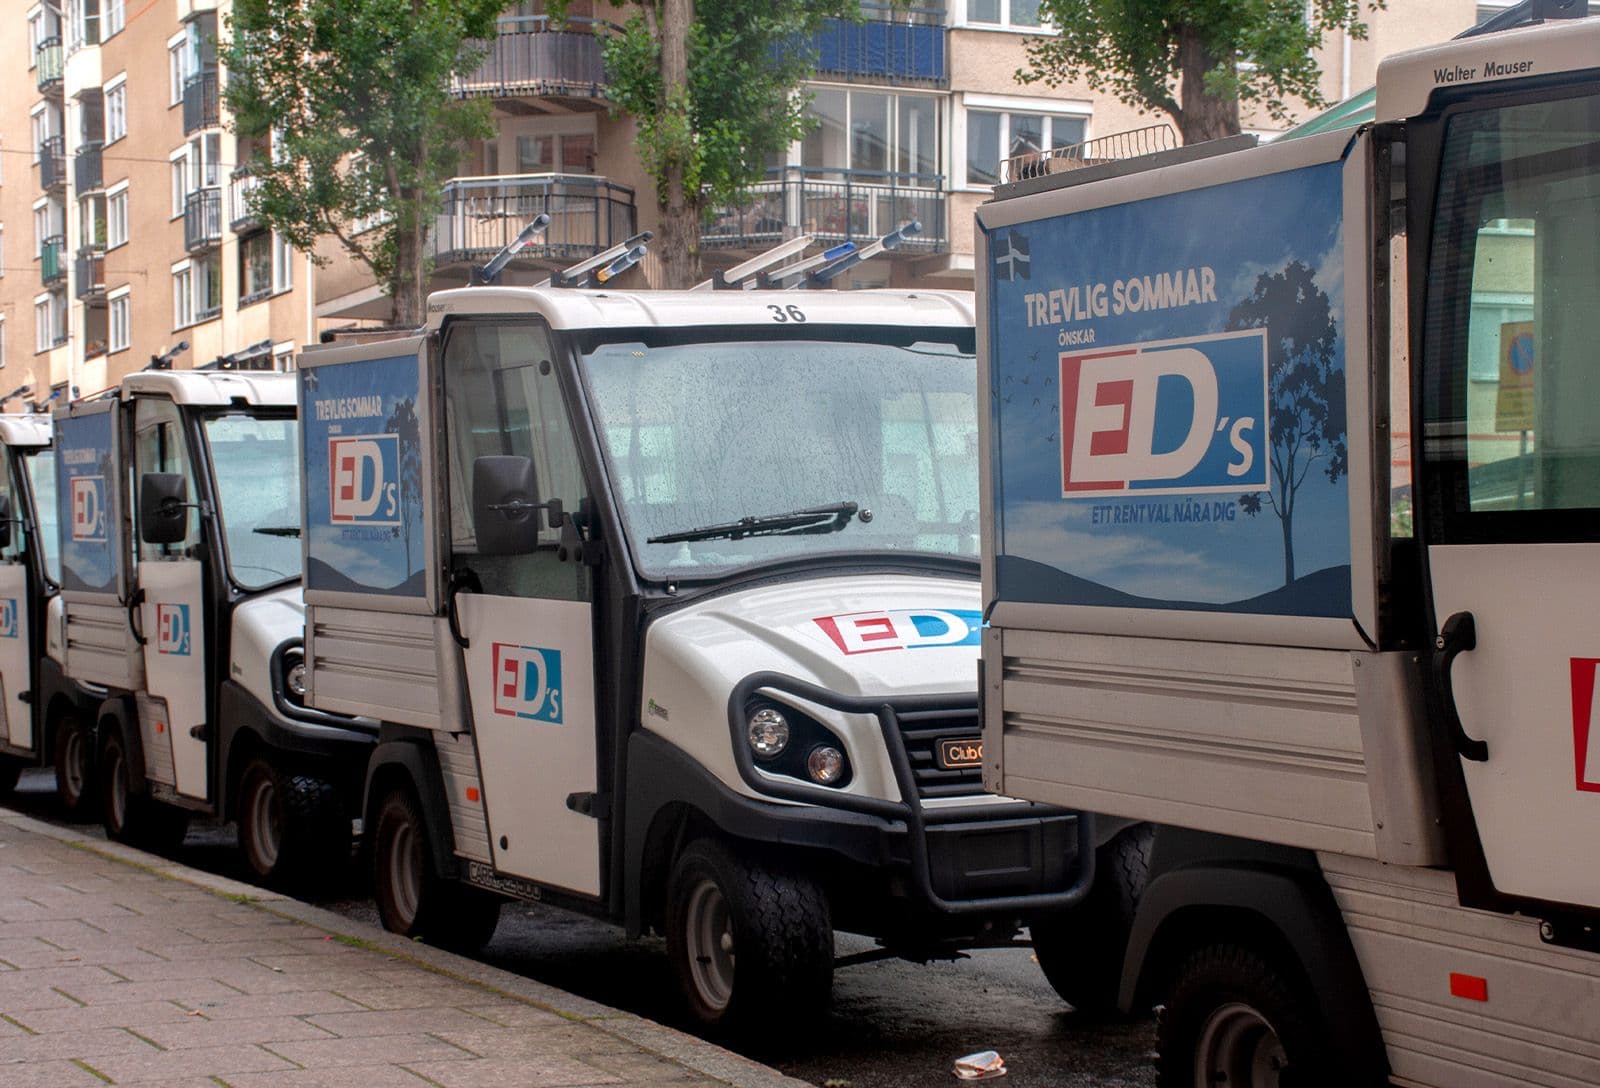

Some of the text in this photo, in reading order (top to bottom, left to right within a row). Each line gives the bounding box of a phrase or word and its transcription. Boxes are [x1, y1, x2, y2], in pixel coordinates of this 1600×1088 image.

[1433, 60, 1534, 83] Walter Mauser
[1024, 266, 1218, 328] TREVLIG SOMMAR
[766, 304, 807, 323] 36
[1058, 328, 1096, 346] ÖNSKAR
[1092, 505, 1112, 524] ETT
[1113, 504, 1146, 524] RENT
[1147, 503, 1172, 523] VAL
[1213, 501, 1236, 522] DIG
